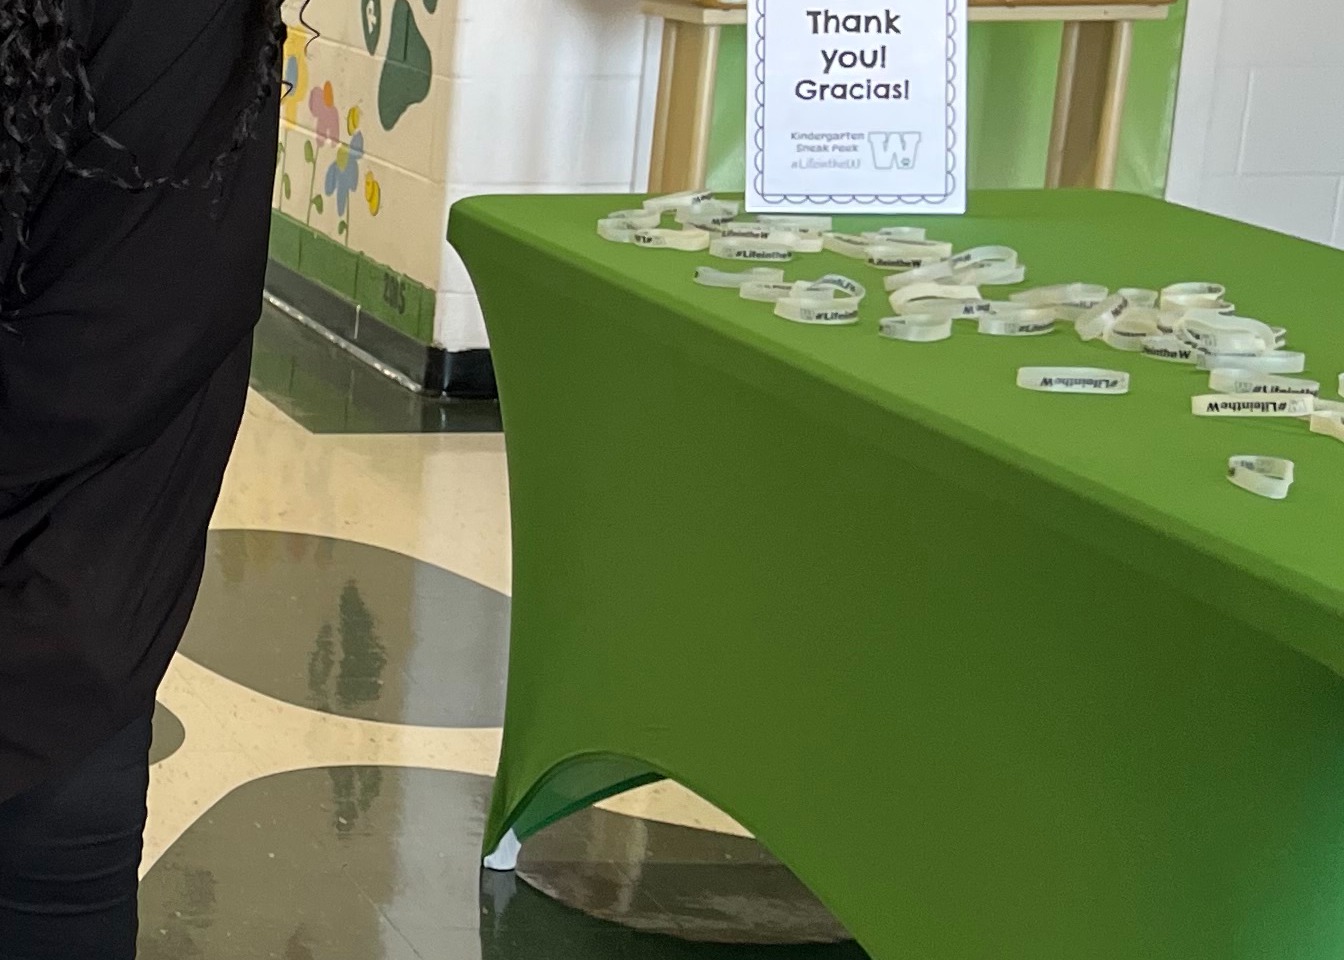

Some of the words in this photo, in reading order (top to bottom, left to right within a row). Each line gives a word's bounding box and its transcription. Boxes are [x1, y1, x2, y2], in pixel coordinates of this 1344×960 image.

[806, 9, 902, 35] Thank
[820, 45, 887, 75] you!
[794, 78, 910, 101] Gracias!
[790, 131, 865, 143] Kindergarten
[796, 143, 829, 153] Sneak
